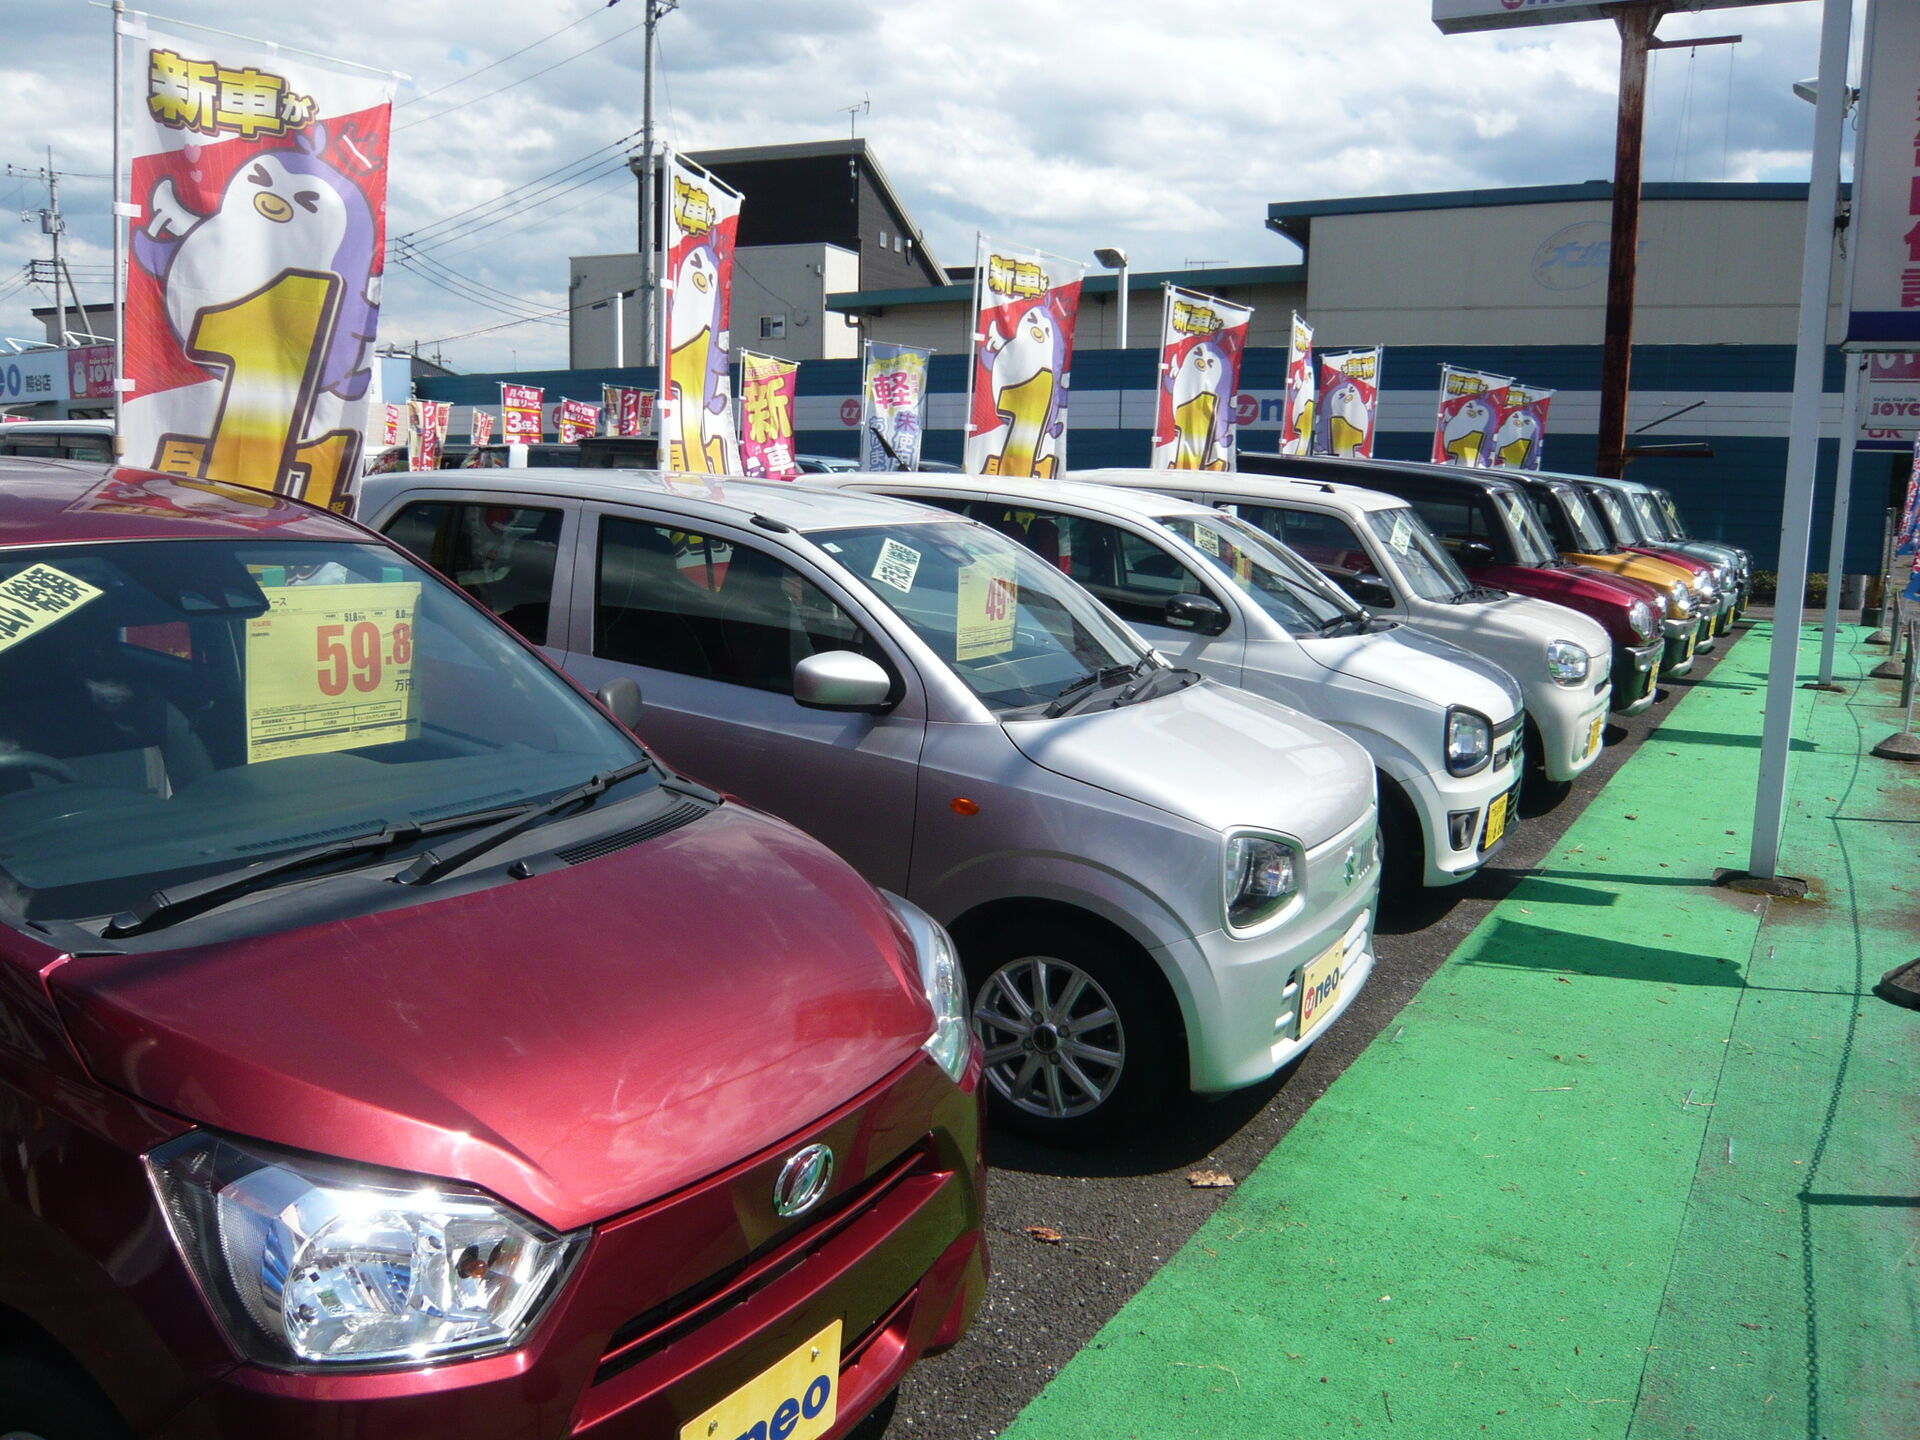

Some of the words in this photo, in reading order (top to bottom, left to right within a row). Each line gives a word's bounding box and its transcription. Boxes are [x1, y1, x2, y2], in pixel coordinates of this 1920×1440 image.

[149, 50, 318, 138] 新車が
[988, 255, 1049, 299] 新車が
[873, 371, 912, 409] 軽
[316, 621, 412, 697] 59.8
